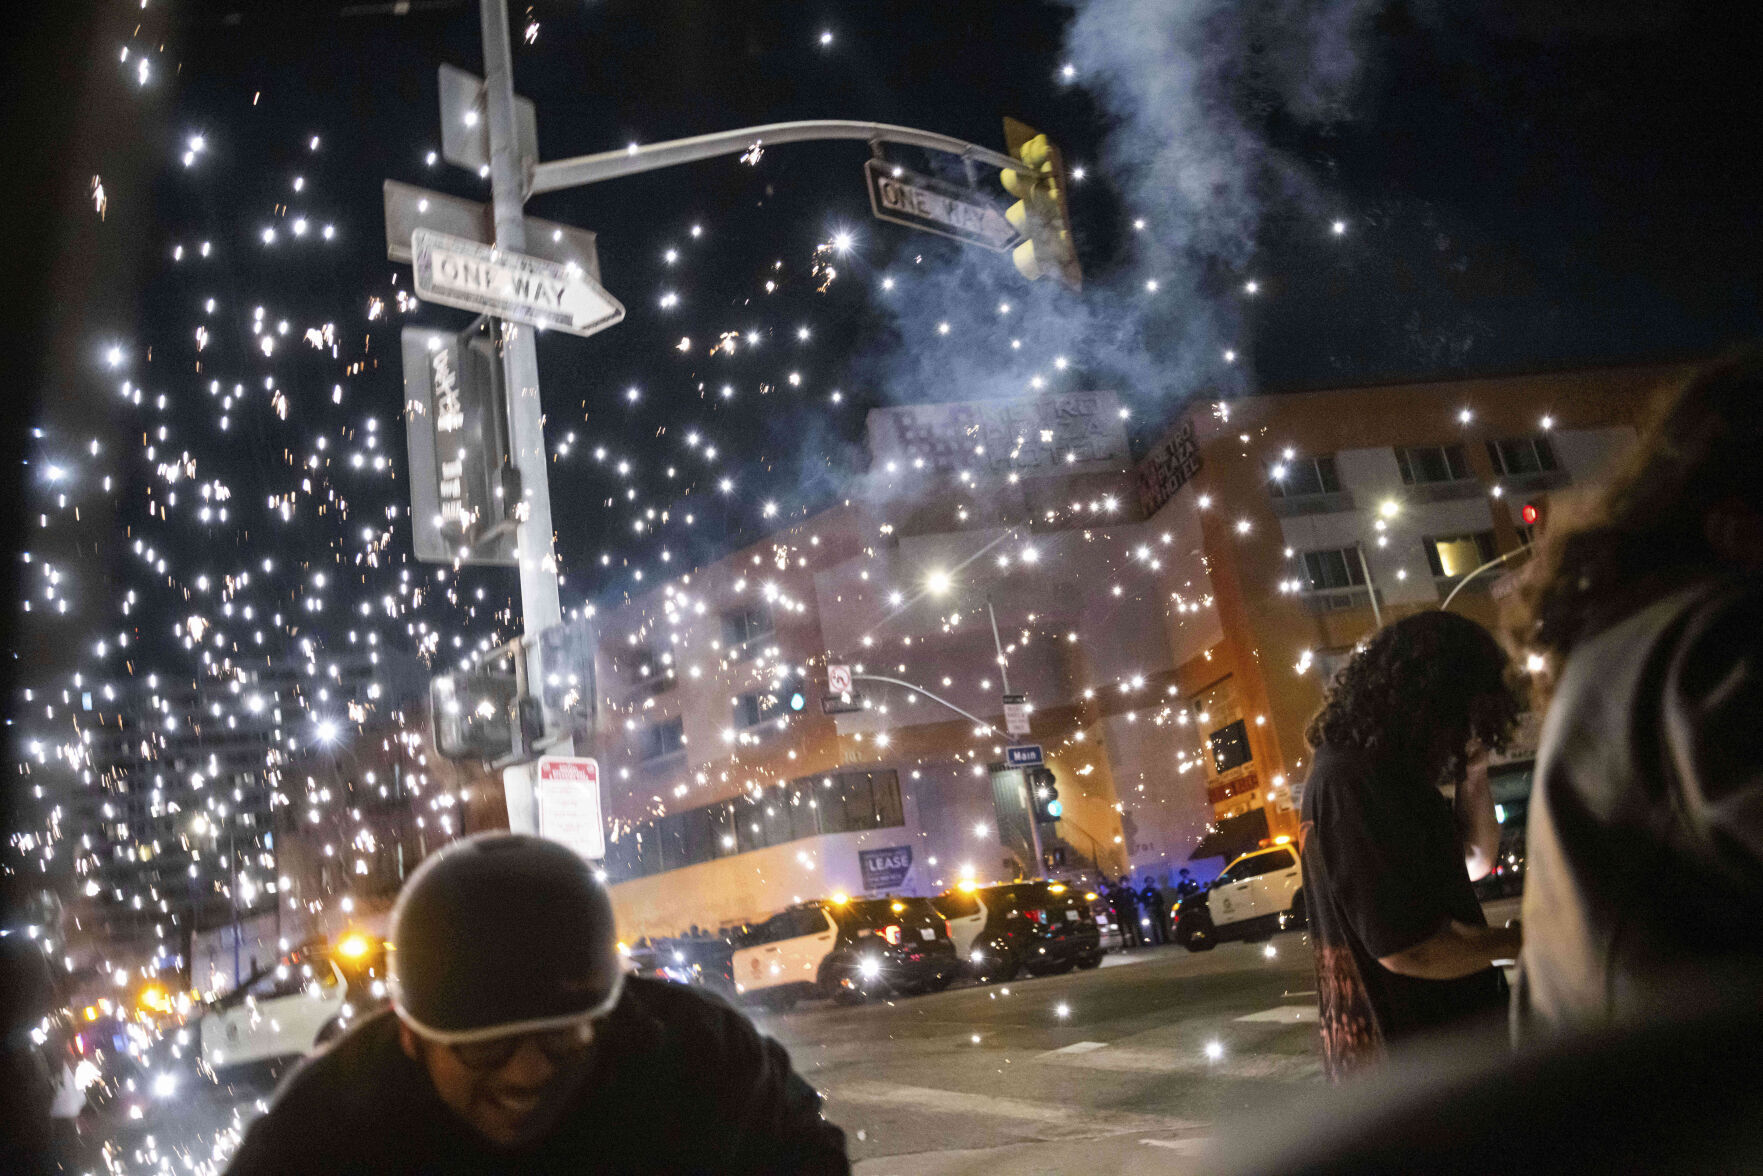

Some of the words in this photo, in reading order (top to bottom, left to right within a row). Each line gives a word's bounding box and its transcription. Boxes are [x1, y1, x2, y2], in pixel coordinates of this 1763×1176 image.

[883, 181, 931, 216] ONE
[943, 199, 986, 233] WAY
[512, 276, 566, 306] WAY
[1158, 440, 1195, 485] PLAZA
[1161, 457, 1200, 501] HOTEL
[1013, 751, 1036, 761] Main
[868, 855, 909, 872] LEASE
